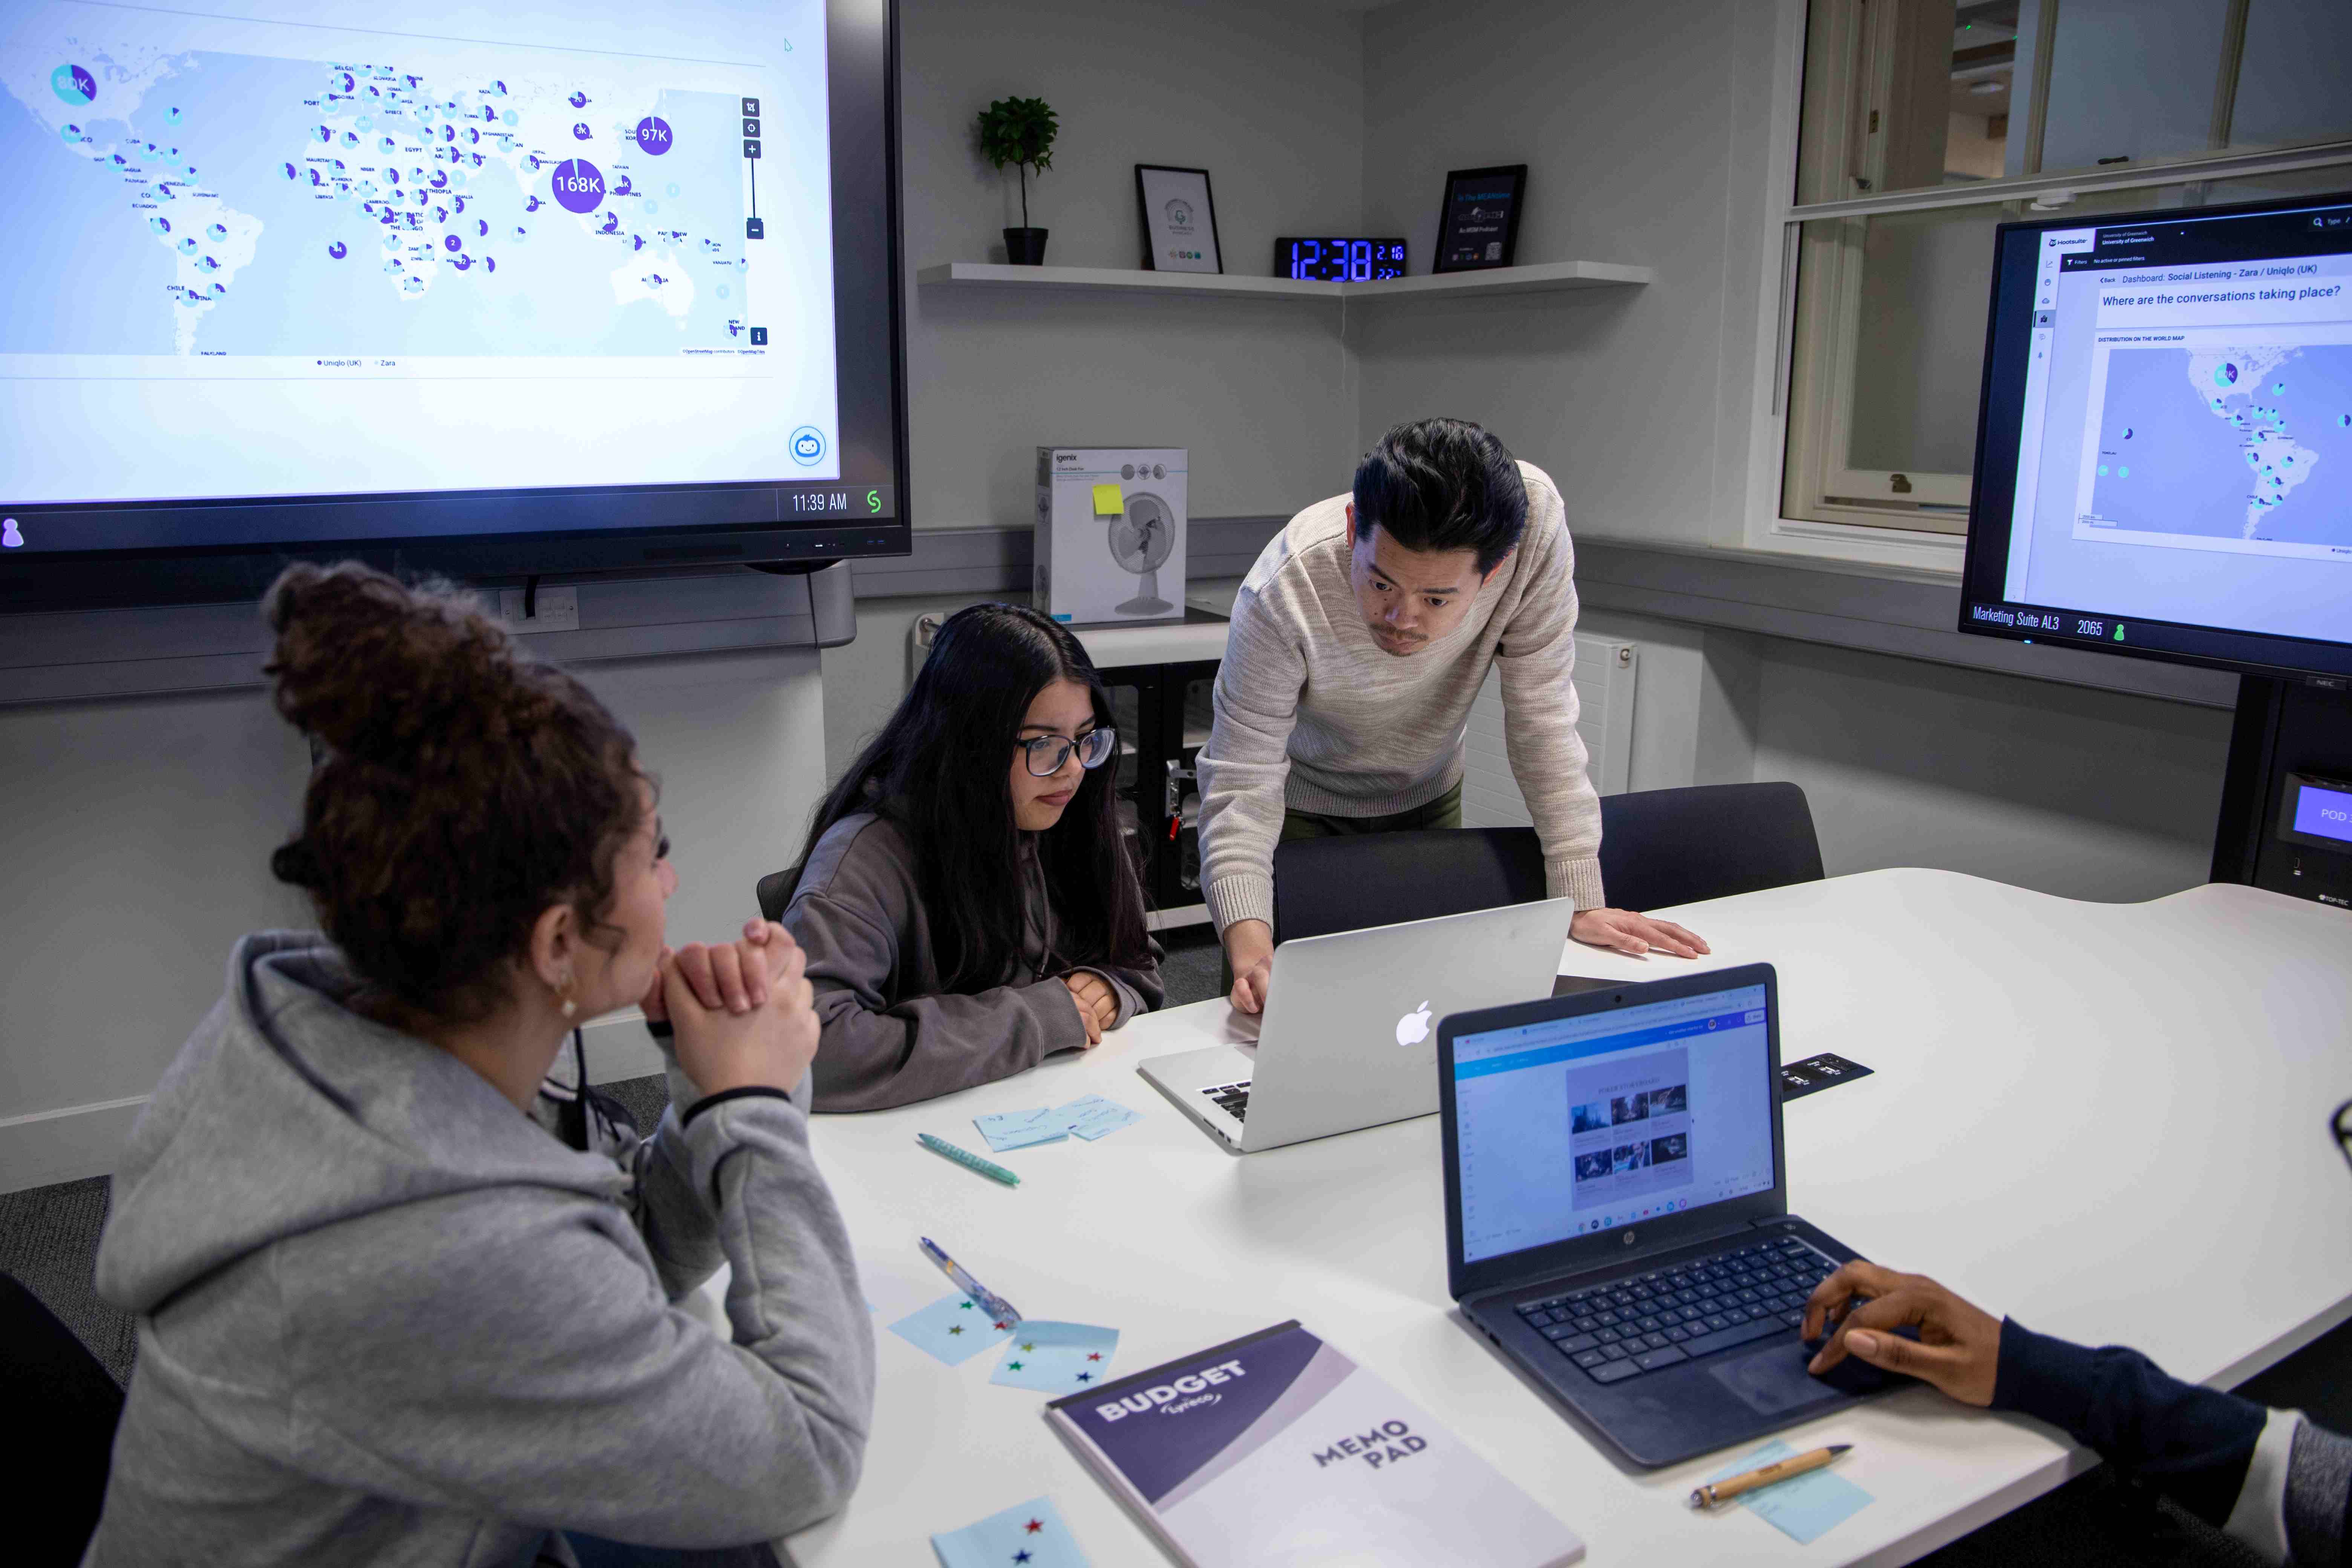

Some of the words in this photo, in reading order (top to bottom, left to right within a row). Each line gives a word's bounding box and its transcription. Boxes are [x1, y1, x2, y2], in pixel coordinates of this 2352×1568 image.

[642, 129, 668, 142] 97K
[556, 176, 601, 193] 168K
[1291, 240, 1371, 282] 12:38
[2122, 274, 2165, 283] Dashboard:
[2168, 272, 2192, 281] Social
[2194, 270, 2231, 282] Listening
[2239, 268, 2259, 277] Zara
[2267, 266, 2294, 277] Uniqlo
[2297, 264, 2318, 275] (UK)
[2103, 295, 2134, 306] Where
[2137, 297, 2154, 305] are
[2157, 294, 2174, 304] the
[2177, 290, 2256, 303] conversations
[2259, 287, 2295, 302] taking
[2299, 285, 2341, 300] place?
[1056, 454, 1077, 463] igenix
[793, 494, 825, 511] 11:39
[829, 493, 847, 510] AM
[1973, 606, 2014, 627] Marketing
[2018, 612, 2038, 628] Suite
[2041, 614, 2060, 631] AL3
[2078, 620, 2103, 636] 2065
[2321, 808, 2347, 821] POD
[1095, 1359, 1247, 1423] BUDGET
[1312, 1419, 1410, 1469] MEMO
[1362, 1434, 1428, 1470] PAD
